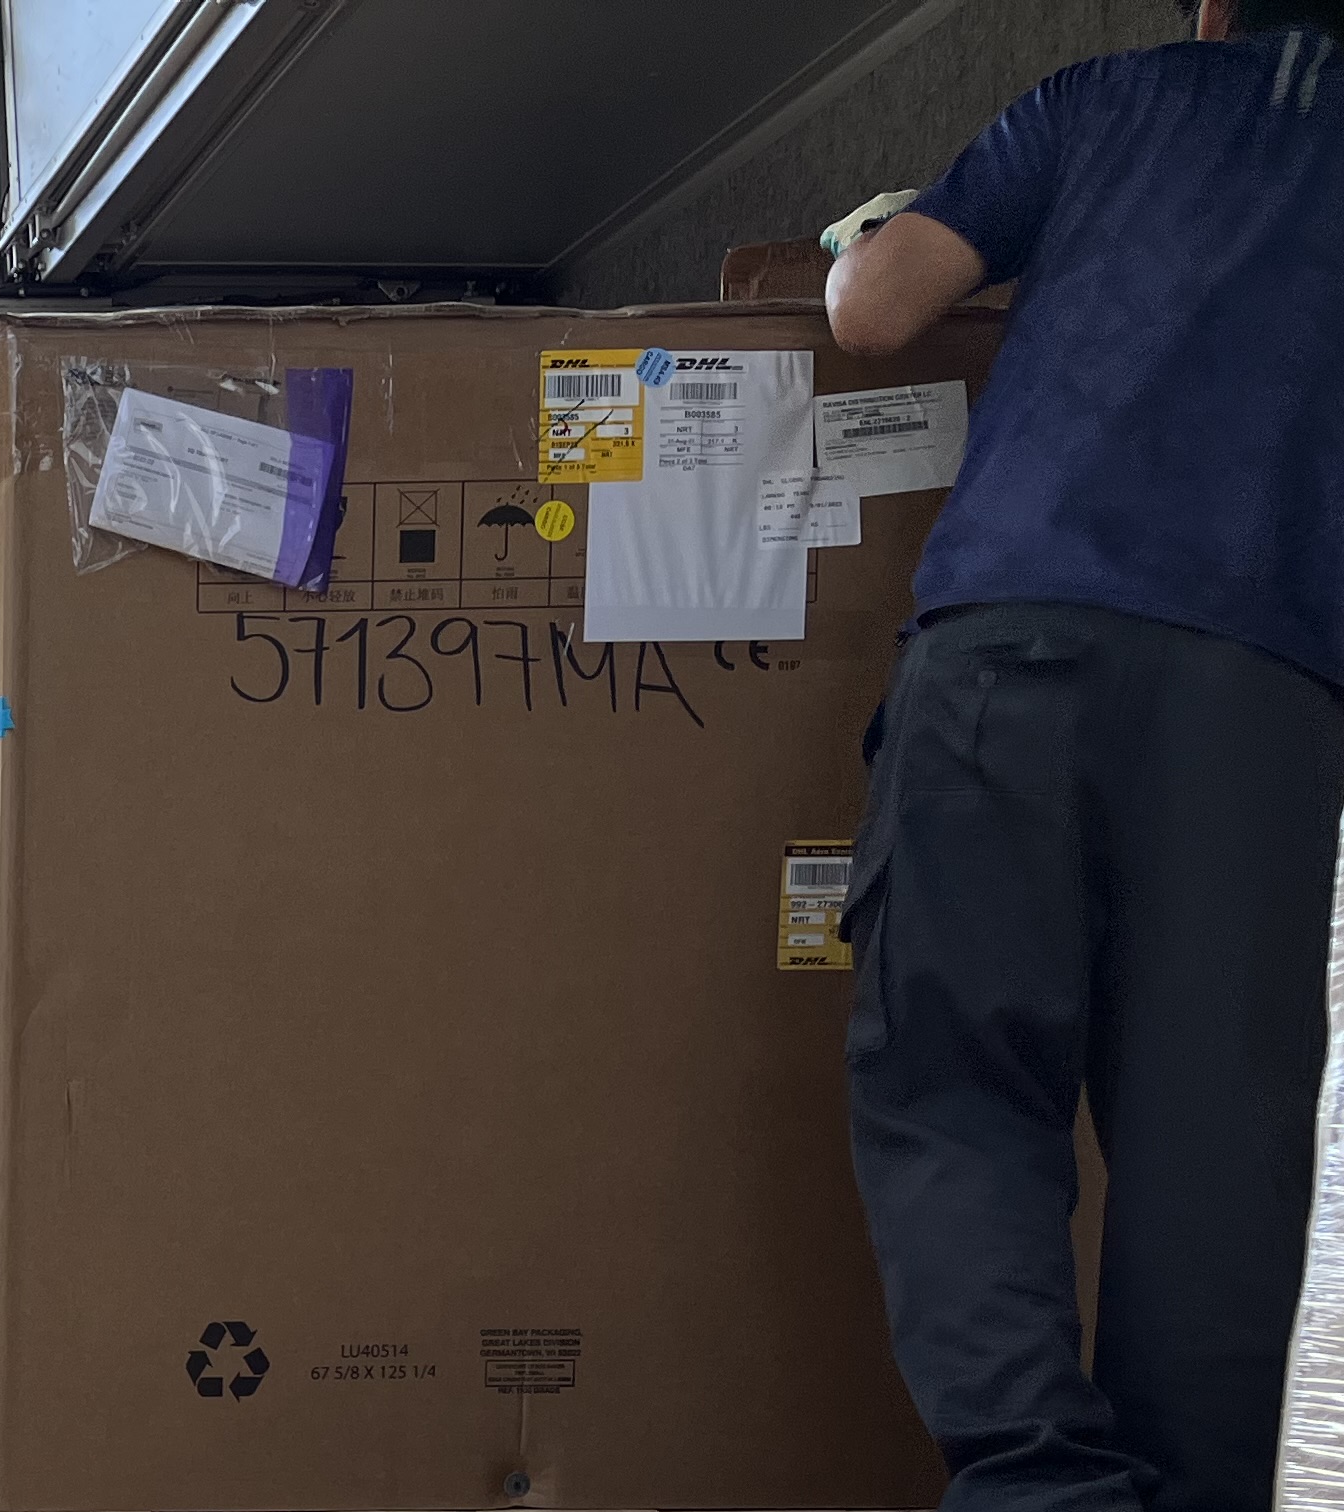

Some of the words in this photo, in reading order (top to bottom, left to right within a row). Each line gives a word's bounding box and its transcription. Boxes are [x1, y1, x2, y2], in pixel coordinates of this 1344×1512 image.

[549, 359, 591, 369] DHL
[636, 350, 654, 376] CARGO
[675, 357, 732, 370] DHL
[684, 410, 722, 419] B003585
[624, 427, 629, 436] 3
[227, 590, 254, 604] 向上
[389, 586, 445, 601] 禁止堆码
[491, 585, 519, 600] 怕雨
[230, 612, 705, 729] 571397MA
[789, 957, 828, 966] DHL
[480, 1329, 510, 1337] GREEN
[481, 1339, 510, 1347] GREAT
[512, 1339, 541, 1347] LAKES
[543, 1338, 581, 1346] DIVISION
[341, 1344, 409, 1359] LU40514
[311, 1367, 331, 1381] 67
[334, 1366, 360, 1381] 5/8
[363, 1366, 374, 1380] X
[380, 1366, 407, 1380] 125
[412, 1365, 437, 1380] 1/4
